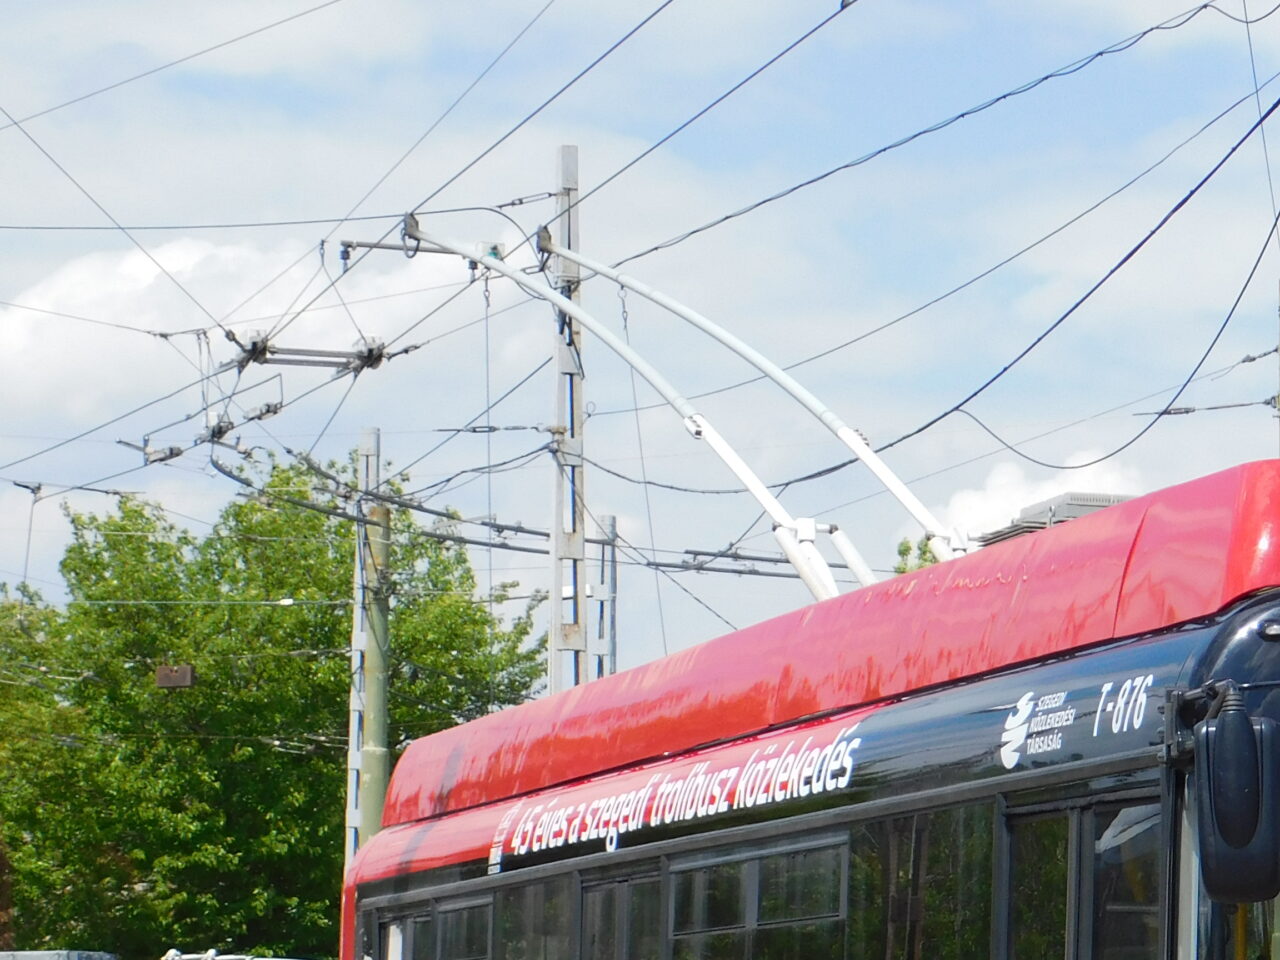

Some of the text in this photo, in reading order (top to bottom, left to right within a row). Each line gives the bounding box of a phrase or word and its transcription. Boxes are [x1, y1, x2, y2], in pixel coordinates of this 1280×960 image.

[1035, 691, 1068, 712] SZEGEDI
[1093, 674, 1154, 737] T-876
[1028, 706, 1077, 734] KÖZLEKEDÉSI
[1026, 730, 1062, 755] TÁRSASÁG
[512, 804, 544, 856] 45
[532, 796, 572, 852] éves
[568, 802, 587, 845] a
[581, 774, 660, 852] szegedi
[651, 761, 740, 827] trolibusz
[733, 723, 862, 810] közlekedés
